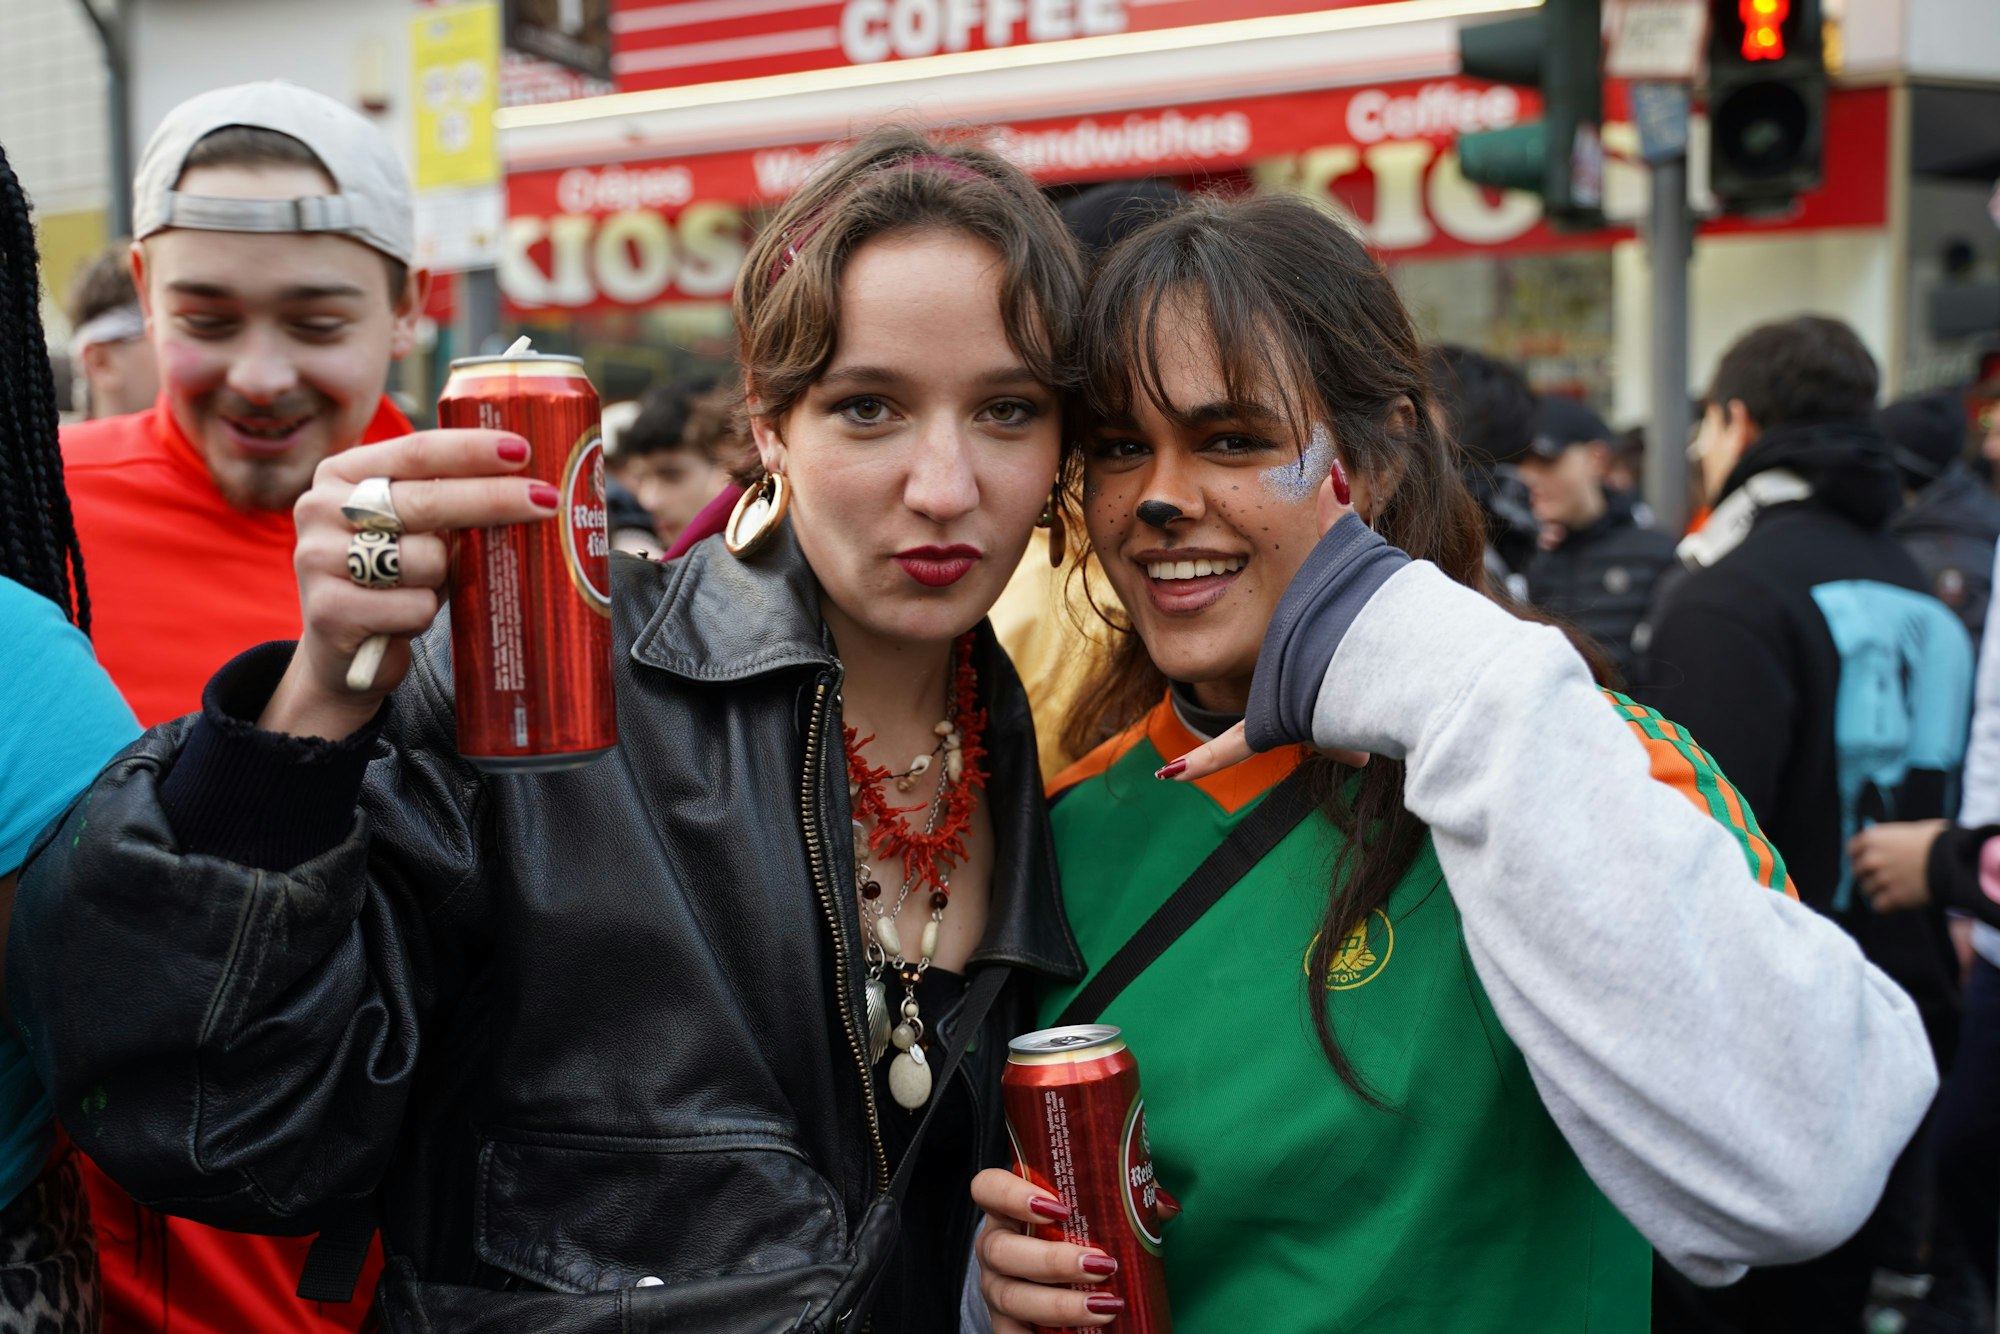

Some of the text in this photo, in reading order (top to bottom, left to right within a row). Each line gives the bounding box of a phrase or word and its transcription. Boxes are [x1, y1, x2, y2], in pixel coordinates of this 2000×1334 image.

[985, 108, 1251, 176] Sandwiches
[1346, 84, 1520, 144] Coffee
[1253, 126, 1660, 246] KIO
[497, 202, 745, 307] KIOS
